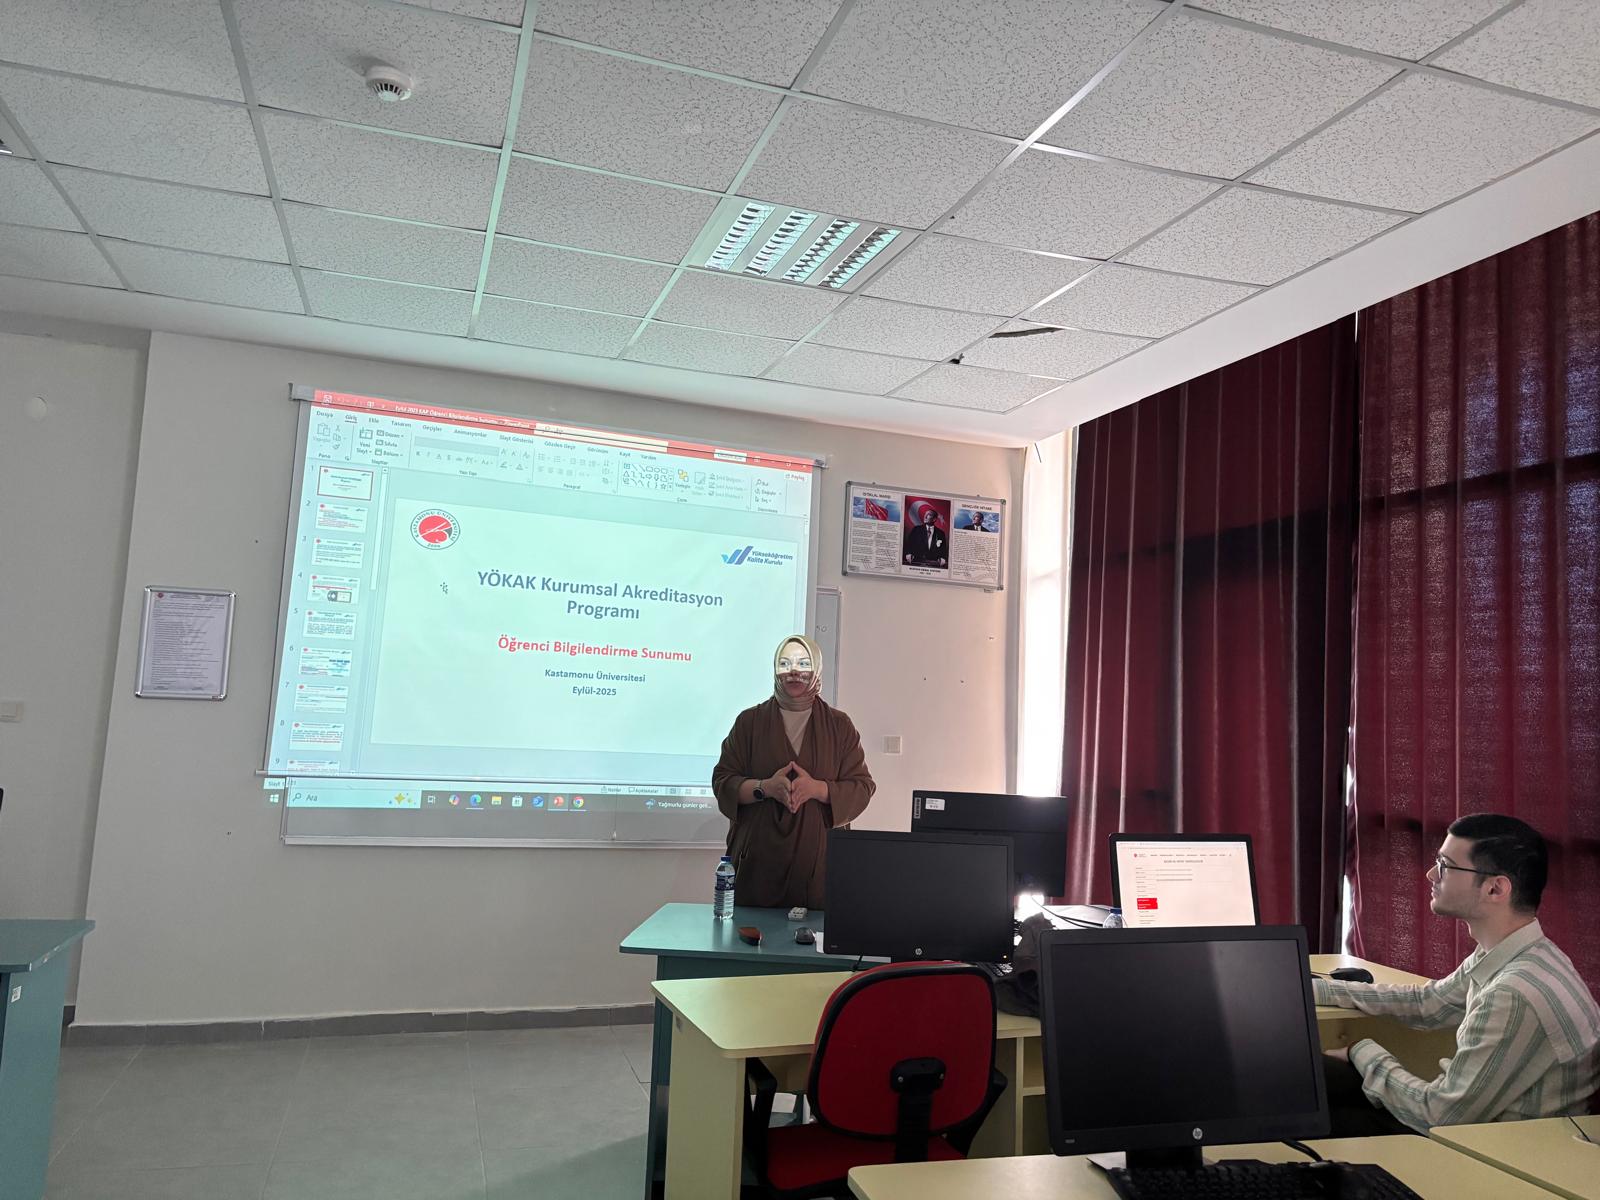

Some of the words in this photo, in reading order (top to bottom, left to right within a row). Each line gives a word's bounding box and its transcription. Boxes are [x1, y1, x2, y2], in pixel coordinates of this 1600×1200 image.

[752, 551, 793, 560] Yükseköğretim
[478, 569, 536, 590] YÖKAK
[541, 577, 618, 596] Kurumsal
[622, 585, 723, 607] Akreditasyon
[567, 600, 640, 619] Programı
[498, 634, 550, 652] Öğrenci
[553, 641, 638, 658] Bilgilendirme
[641, 648, 692, 661] Sunumu
[545, 669, 594, 680] Kastamonu
[596, 671, 646, 683] Üniversitesi
[572, 686, 617, 696] Eylül-2025
